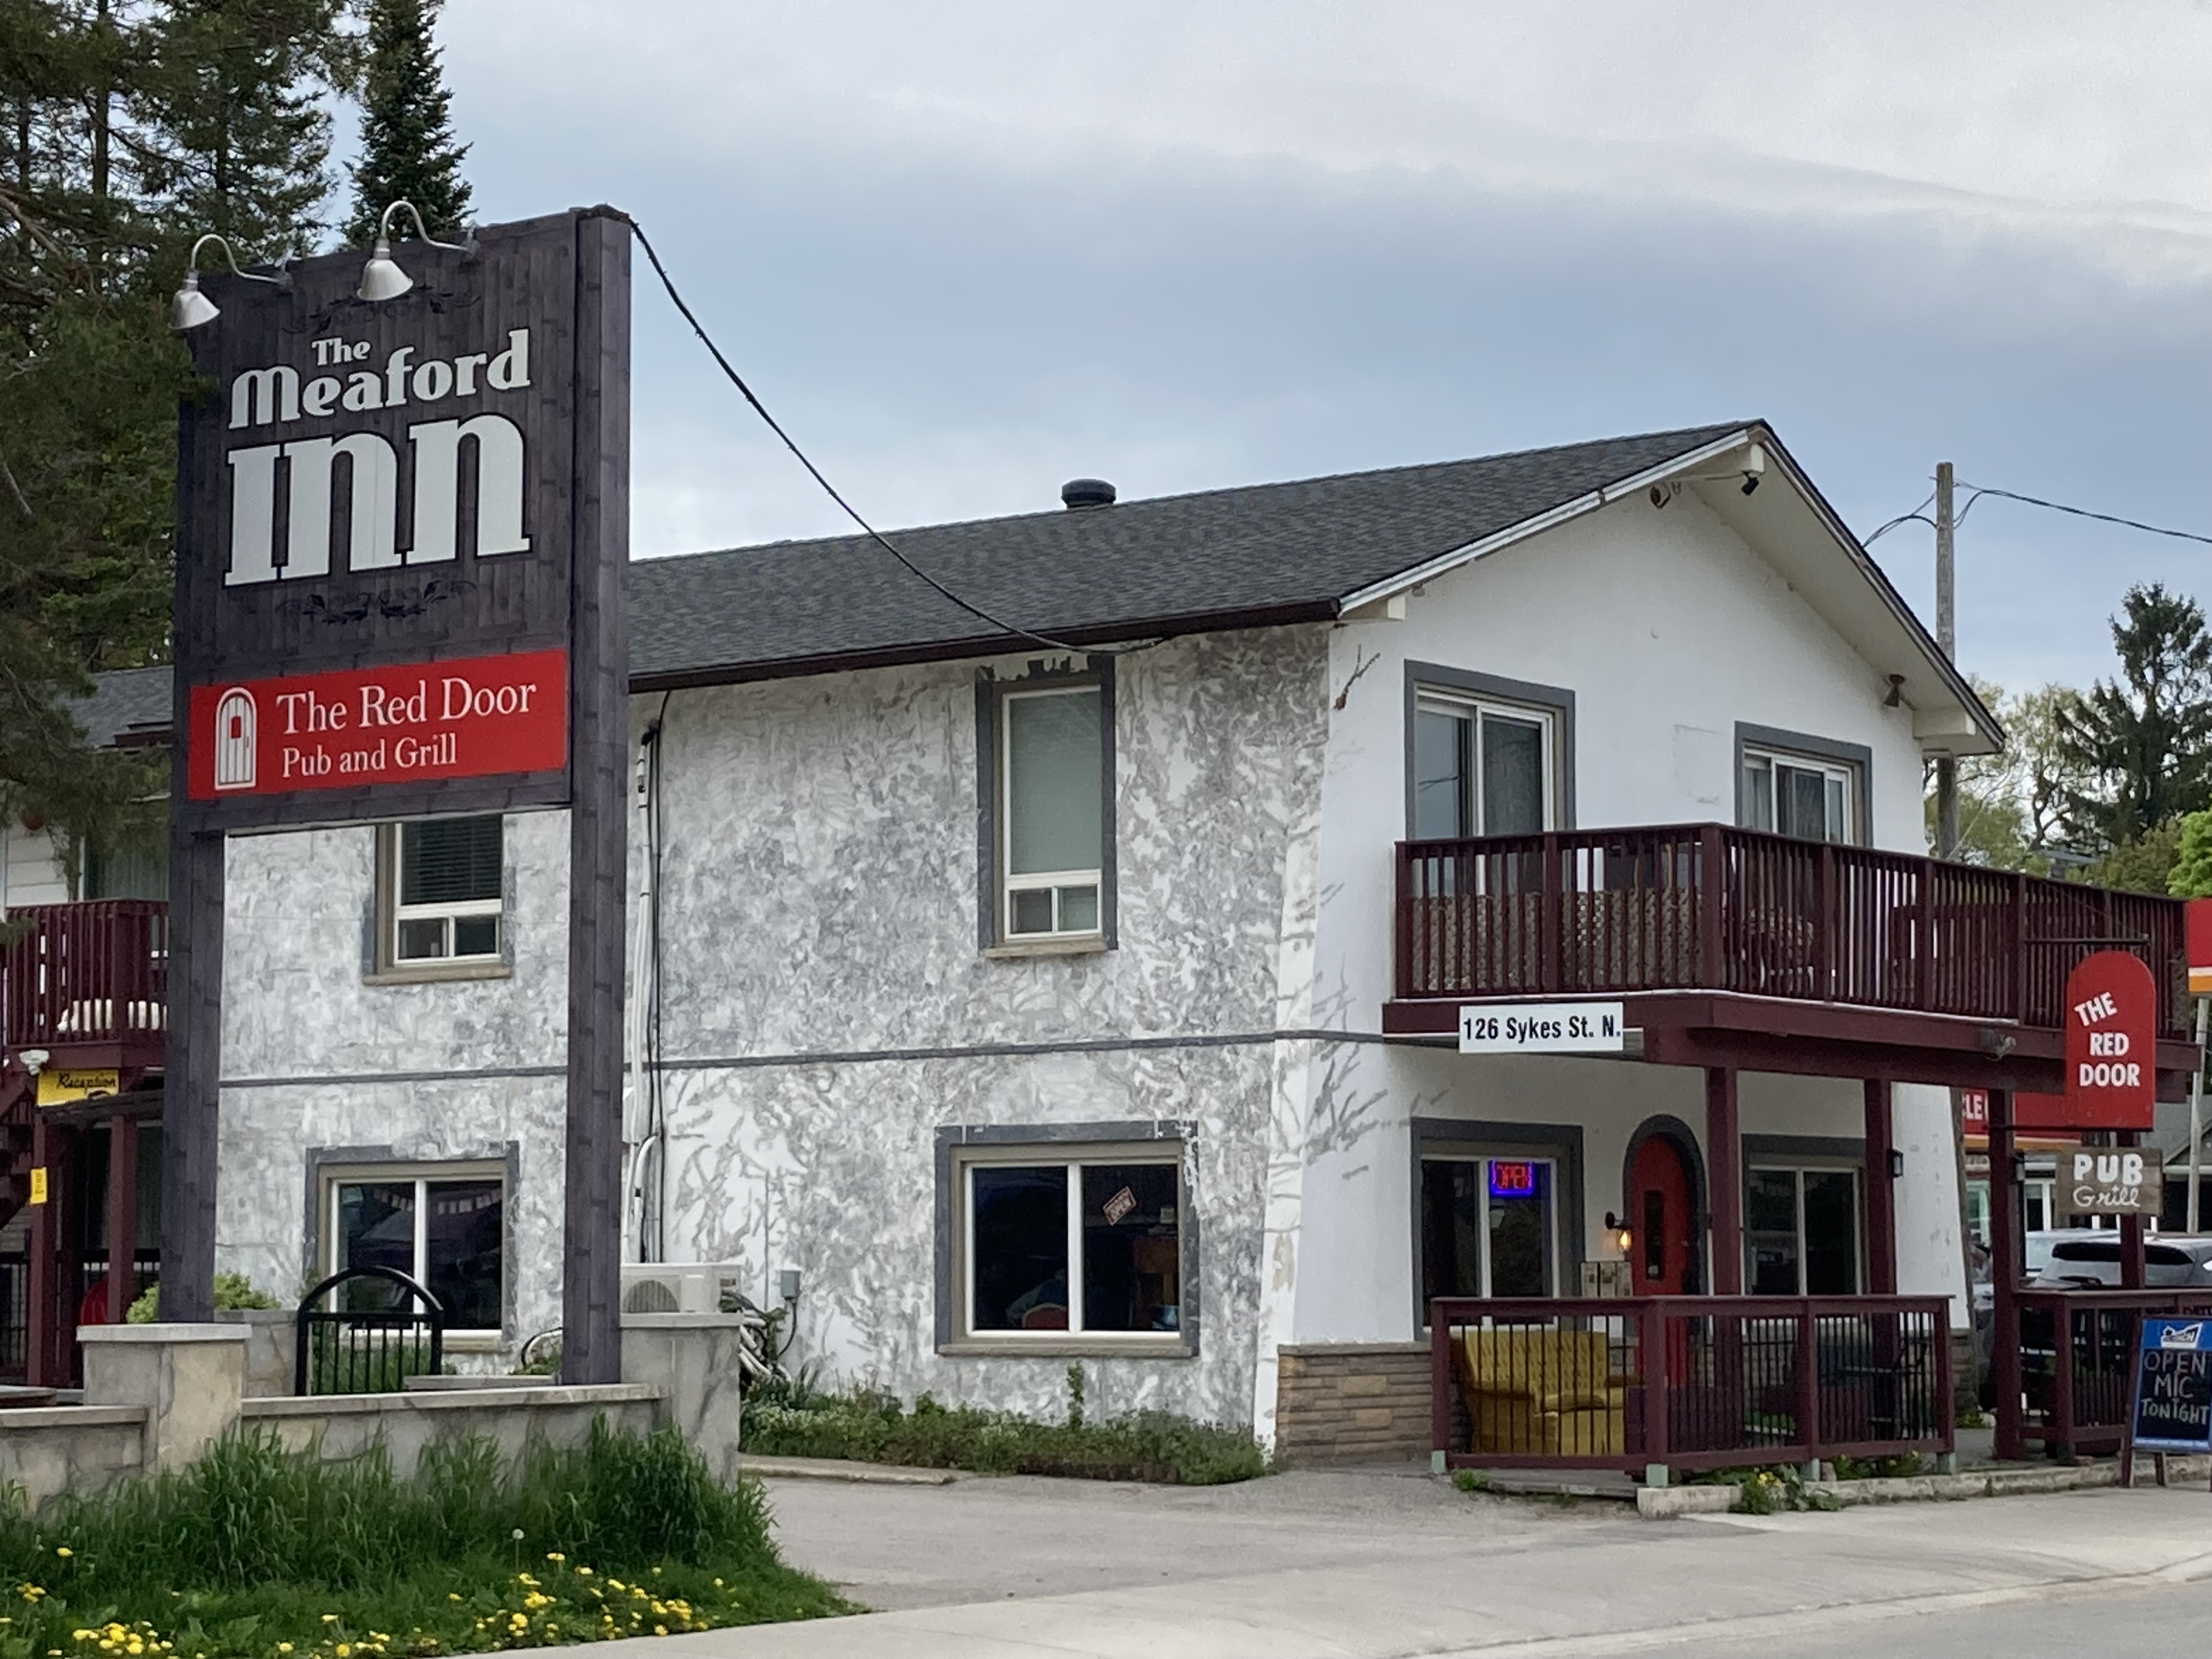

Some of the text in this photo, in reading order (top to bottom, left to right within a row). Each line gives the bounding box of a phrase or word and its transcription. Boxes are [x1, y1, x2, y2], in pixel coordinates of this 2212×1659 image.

[312, 337, 371, 366] The
[229, 329, 531, 429] Meaford
[276, 676, 538, 735] The Red Door
[282, 733, 457, 778] Pub and Grill
[2073, 991, 2118, 1027] THE
[1463, 1014, 1621, 1043] 126 Sykes St. N.
[2089, 1032, 2130, 1056] RED
[2079, 1062, 2141, 1087] DOOR
[2073, 1153, 2143, 1186] PUB
[2073, 1184, 2141, 1207] Grill
[2144, 1351, 2206, 1378] OPEN
[2154, 1370, 2194, 1398] MIC
[2141, 1397, 2210, 1425] TONIGHT
